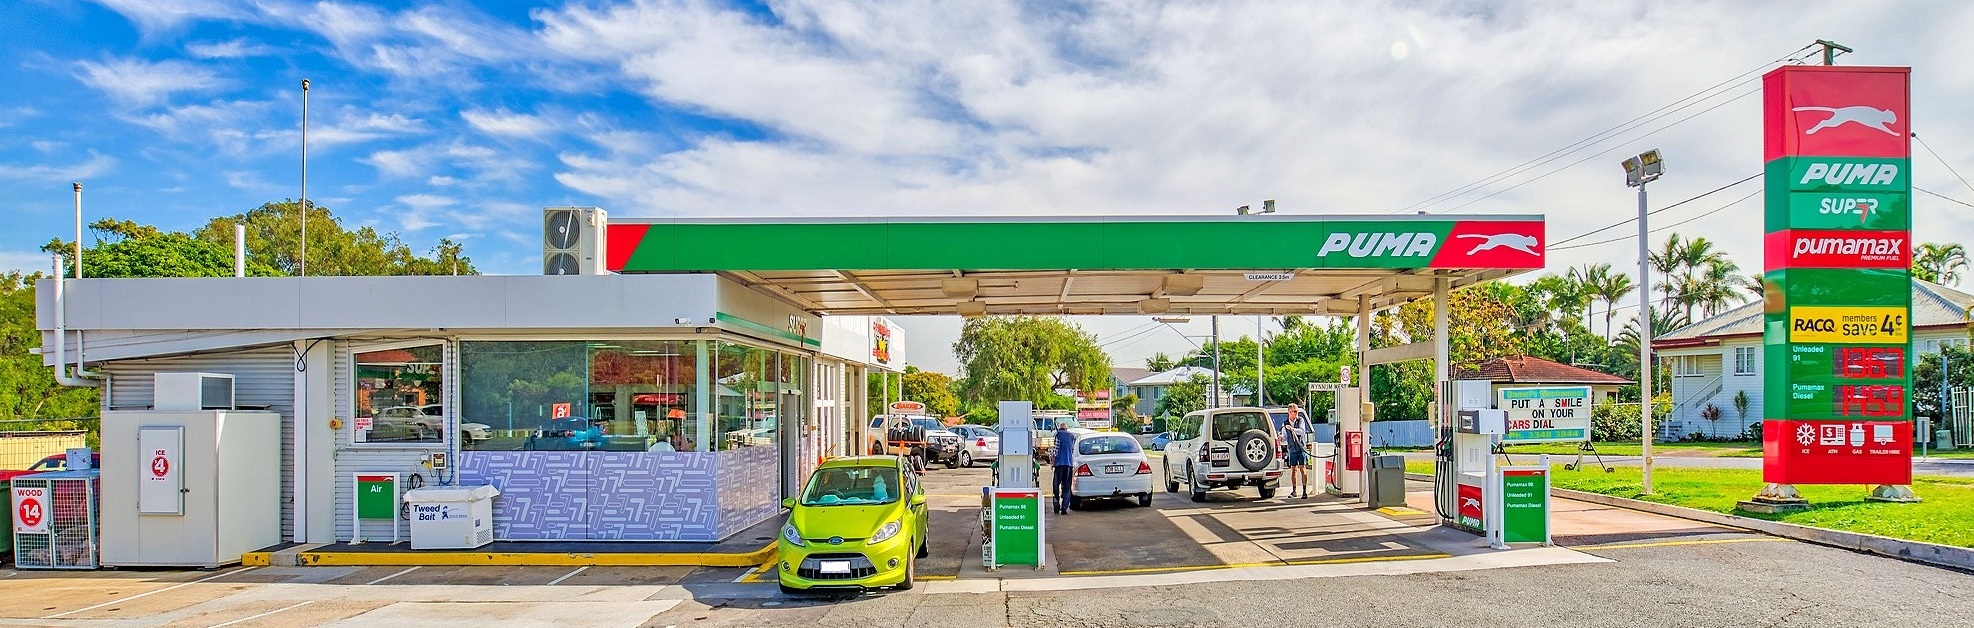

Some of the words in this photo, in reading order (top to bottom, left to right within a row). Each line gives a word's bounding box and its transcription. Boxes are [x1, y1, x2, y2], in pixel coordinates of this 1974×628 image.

[1799, 163, 1898, 185] PUMA
[1316, 232, 1437, 258] PUMA
[1793, 238, 1903, 258] pumamax
[1842, 314, 1877, 322] members
[1794, 318, 1835, 333] RACQ
[1842, 323, 1877, 336] save
[1792, 354, 1801, 362] 91
[1792, 392, 1814, 400] Diesel
[1511, 399, 1531, 409] PUT
[1538, 399, 1545, 408] A
[1555, 398, 1583, 408] SMILE
[1532, 409, 1545, 419] ON
[1550, 408, 1574, 418] YOUR
[1508, 420, 1531, 429] CARS
[1533, 419, 1555, 429] DIAL
[17, 489, 43, 497] WOOD
[370, 484, 383, 493] Air
[413, 504, 441, 513] Tweed
[418, 512, 436, 521] Bait
[1461, 515, 1480, 528] PUMA
